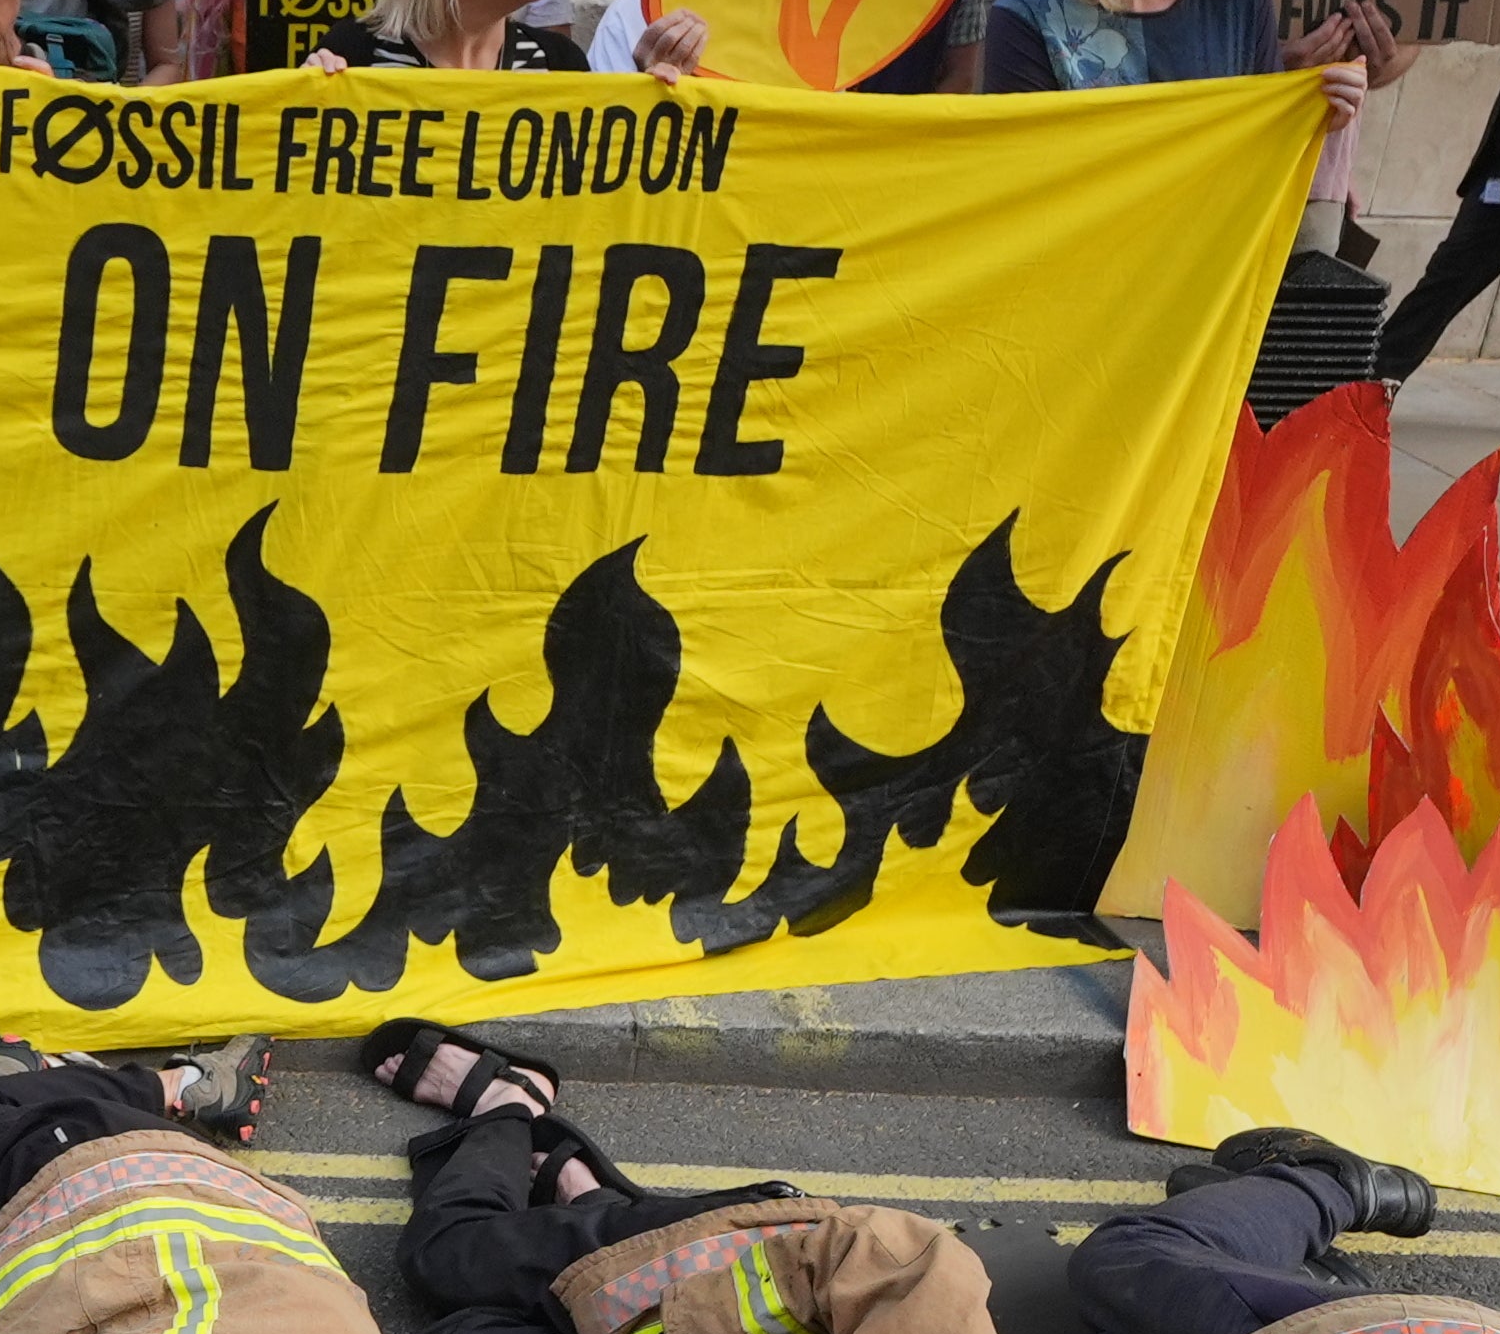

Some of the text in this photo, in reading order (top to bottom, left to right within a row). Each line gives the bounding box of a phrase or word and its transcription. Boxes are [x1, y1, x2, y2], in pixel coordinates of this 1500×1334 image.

[0, 88, 739, 201] FØSSIL FREE LONDON
[51, 222, 322, 472] ON
[378, 243, 844, 475] FIRE
